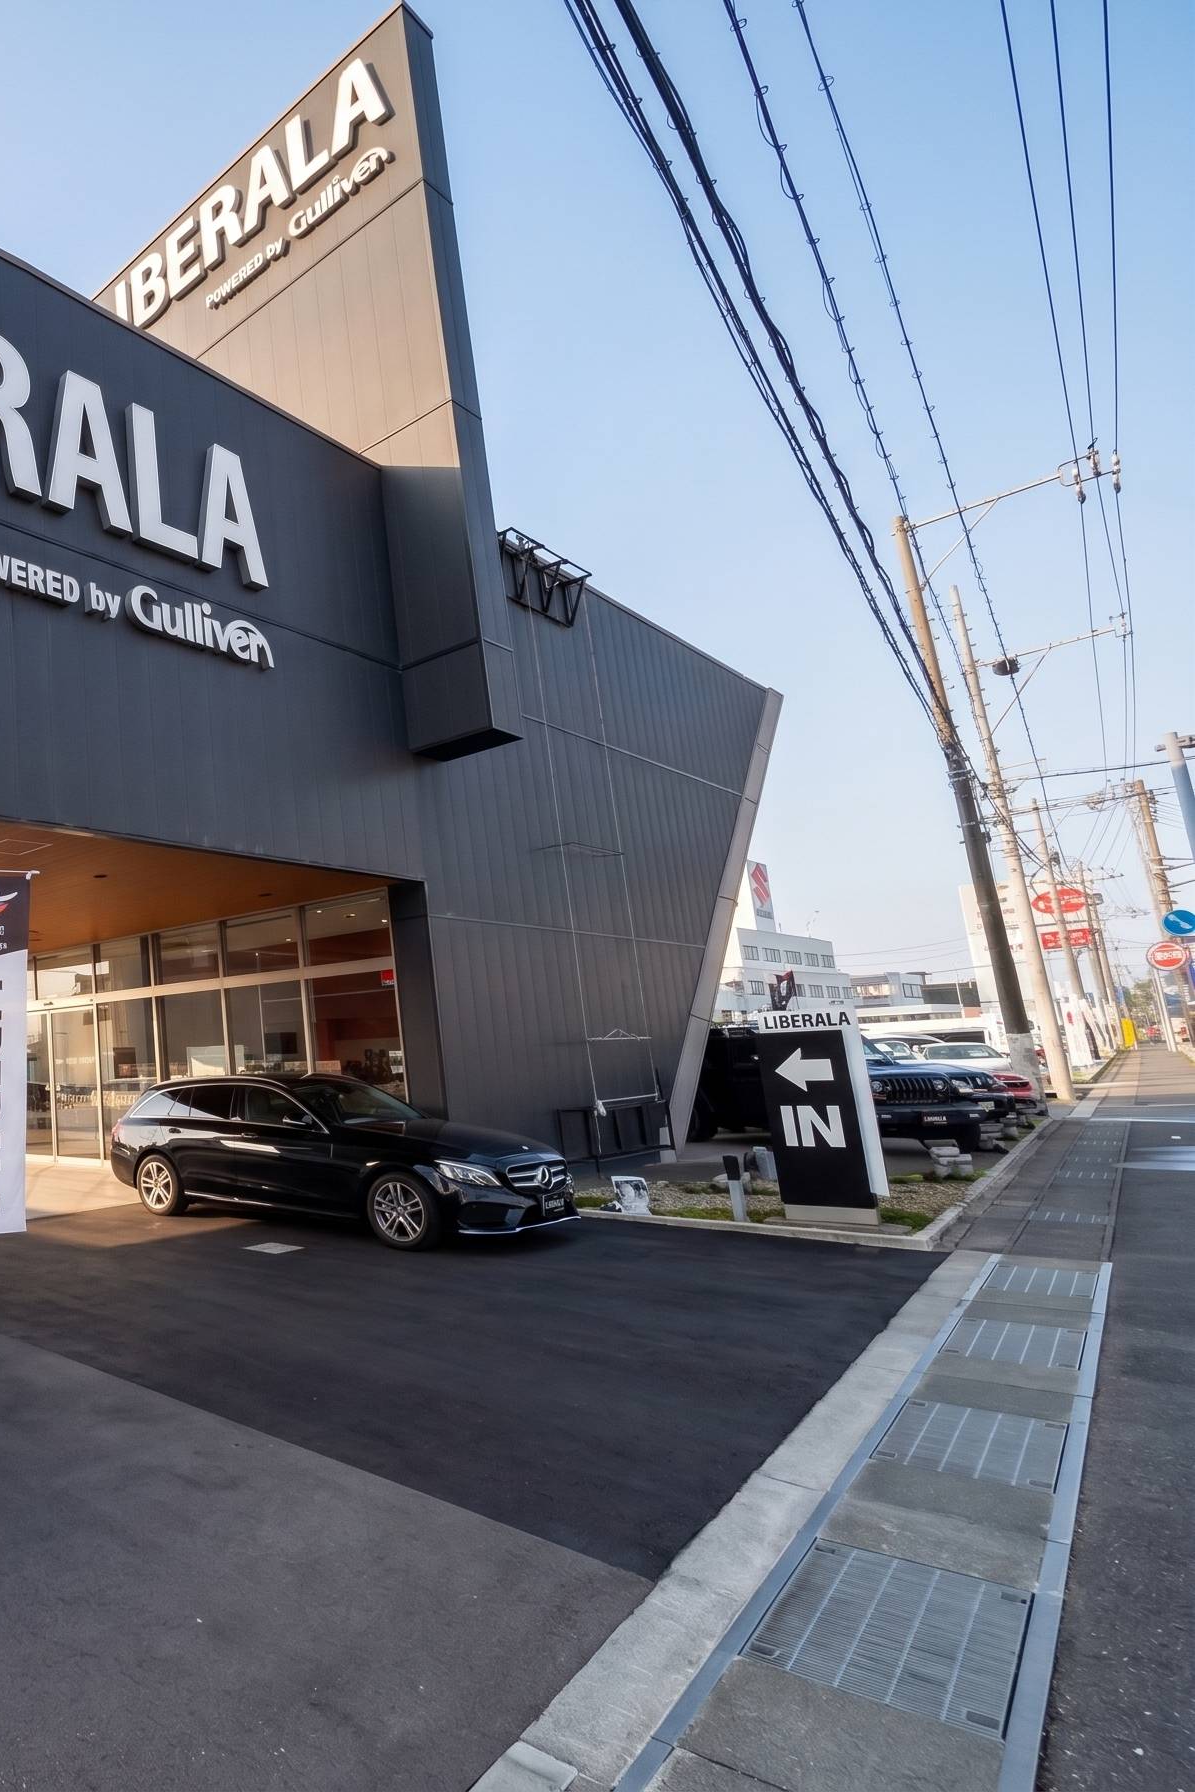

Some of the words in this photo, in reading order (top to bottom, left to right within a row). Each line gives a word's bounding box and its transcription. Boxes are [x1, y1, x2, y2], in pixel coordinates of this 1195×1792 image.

[114, 58, 393, 328] IBERALA
[205, 254, 265, 309] POWERED
[268, 237, 287, 259] by
[289, 147, 393, 239] Gulliver
[85, 582, 121, 619] by
[125, 585, 275, 670] Gulliver
[763, 1011, 851, 1030] LIBERALA
[780, 1105, 846, 1148] IN
